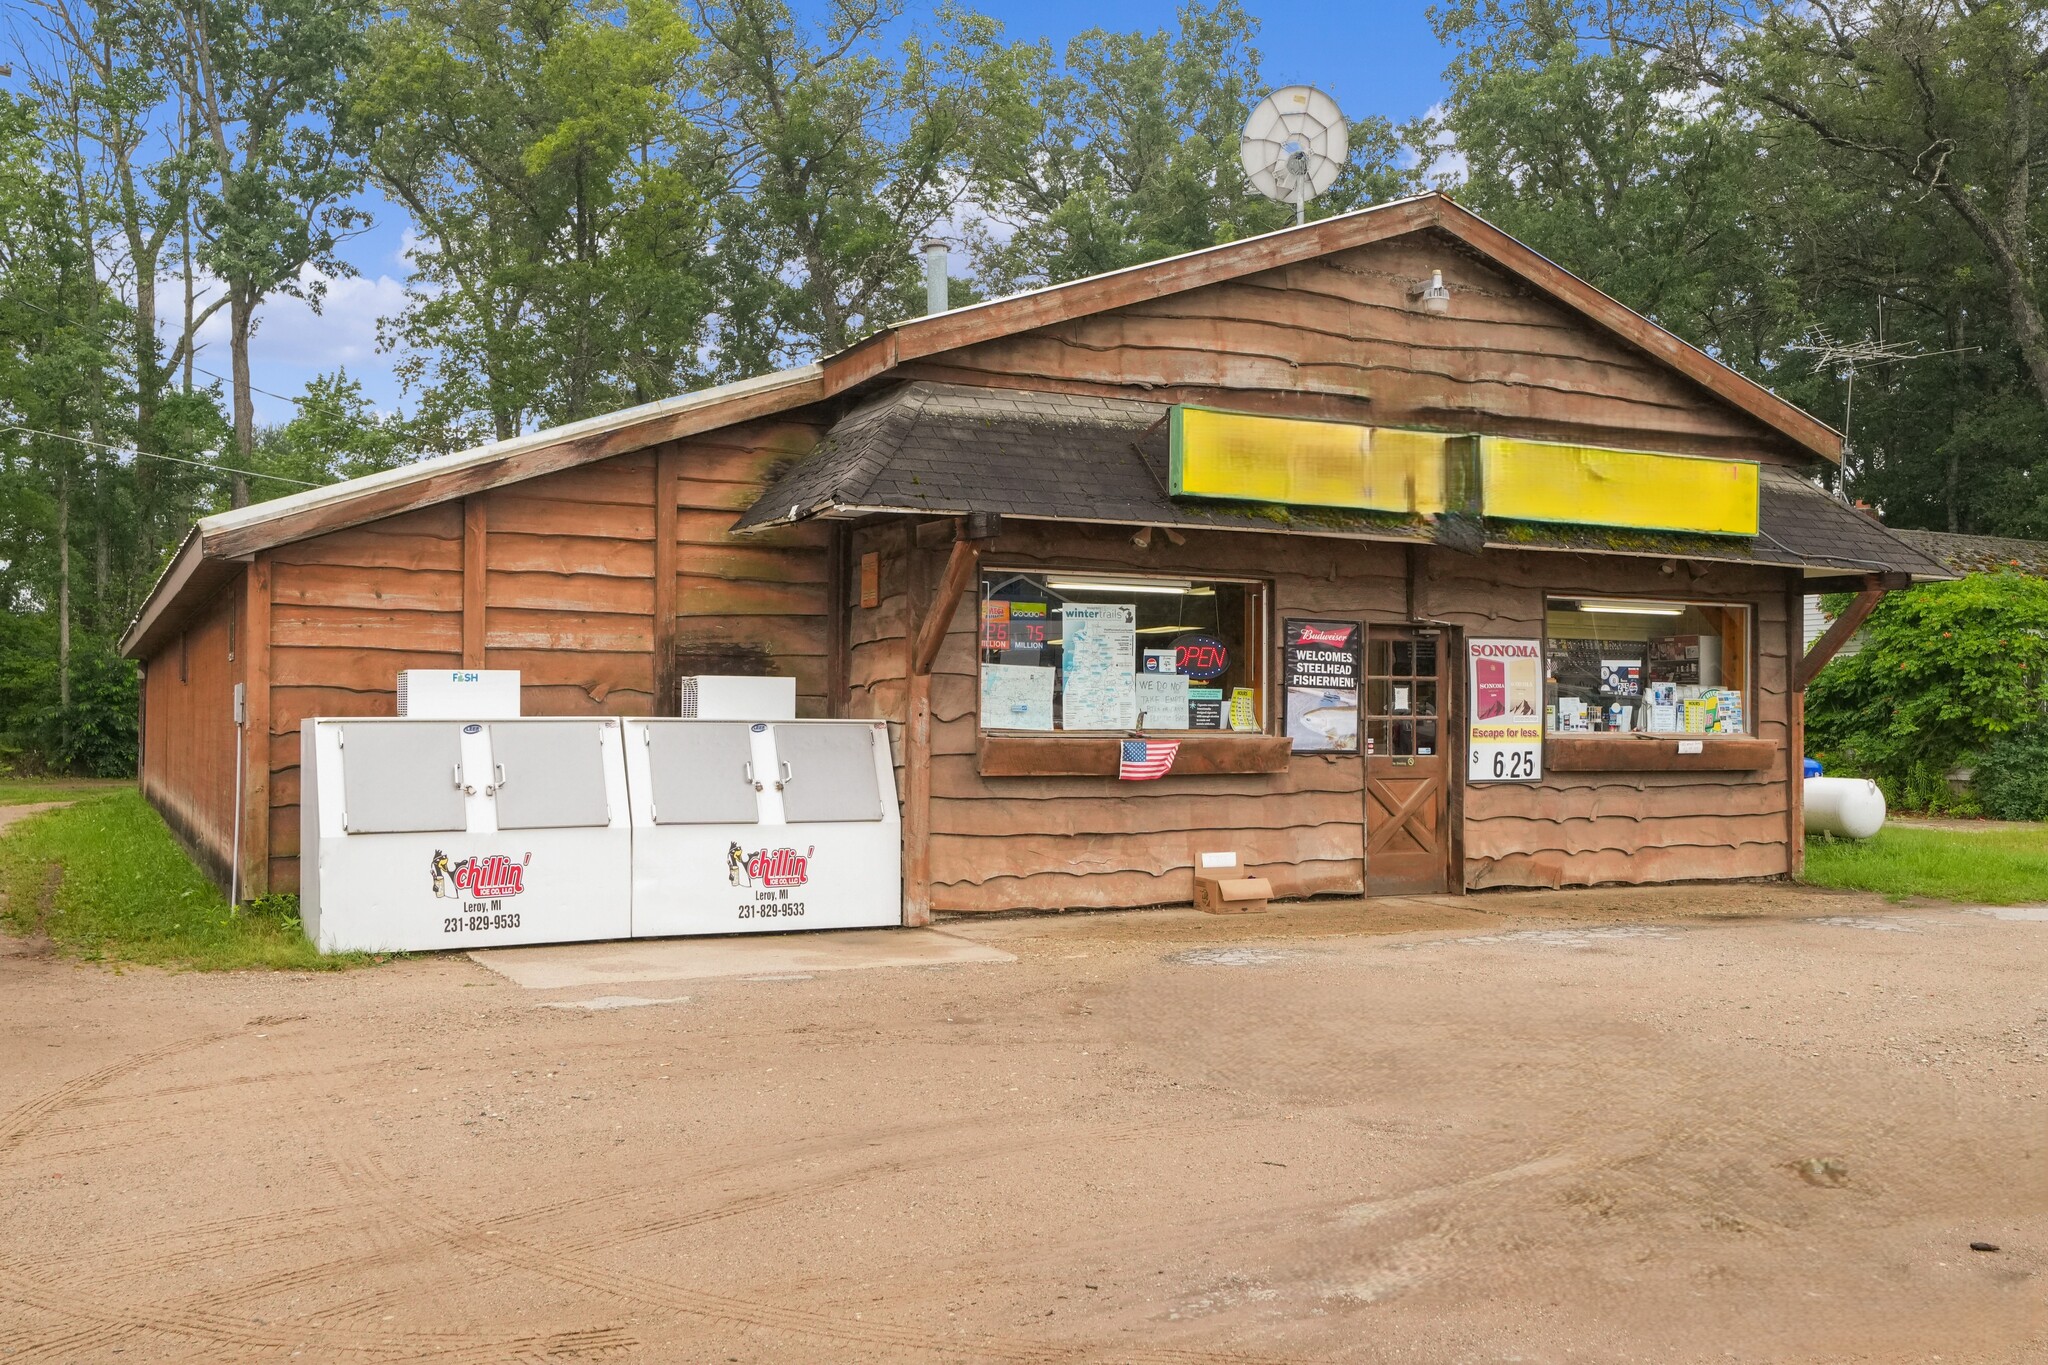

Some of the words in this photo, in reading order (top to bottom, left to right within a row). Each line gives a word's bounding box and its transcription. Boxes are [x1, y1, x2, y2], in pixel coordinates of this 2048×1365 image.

[1026, 625, 1044, 642] 75
[1301, 629, 1348, 642] Budweiser
[1175, 646, 1226, 668] OPEN
[1296, 650, 1352, 662] WELCOMES
[1471, 644, 1538, 658] SONOMA
[1296, 663, 1352, 675] STEELHEAD
[1139, 680, 1154, 690] WE
[1156, 681, 1168, 691] DO
[1171, 681, 1186, 691] NOT
[1293, 675, 1354, 687] FISHERMEN!
[1141, 696, 1160, 704] TAKE
[1473, 728, 1504, 739] Escape
[1507, 728, 1518, 737] for
[1521, 728, 1539, 737] less.
[1473, 751, 1479, 764] $
[1494, 751, 1533, 778] 6.25
[749, 846, 815, 887] chillin'
[454, 852, 531, 899] chillin'
[756, 890, 777, 901] Leroy,
[779, 889, 788, 899] MI
[464, 902, 488, 913] Leroy,
[491, 900, 501, 910] MI
[738, 903, 805, 918] 231-829-9533
[444, 913, 520, 932] 231-829-9533
